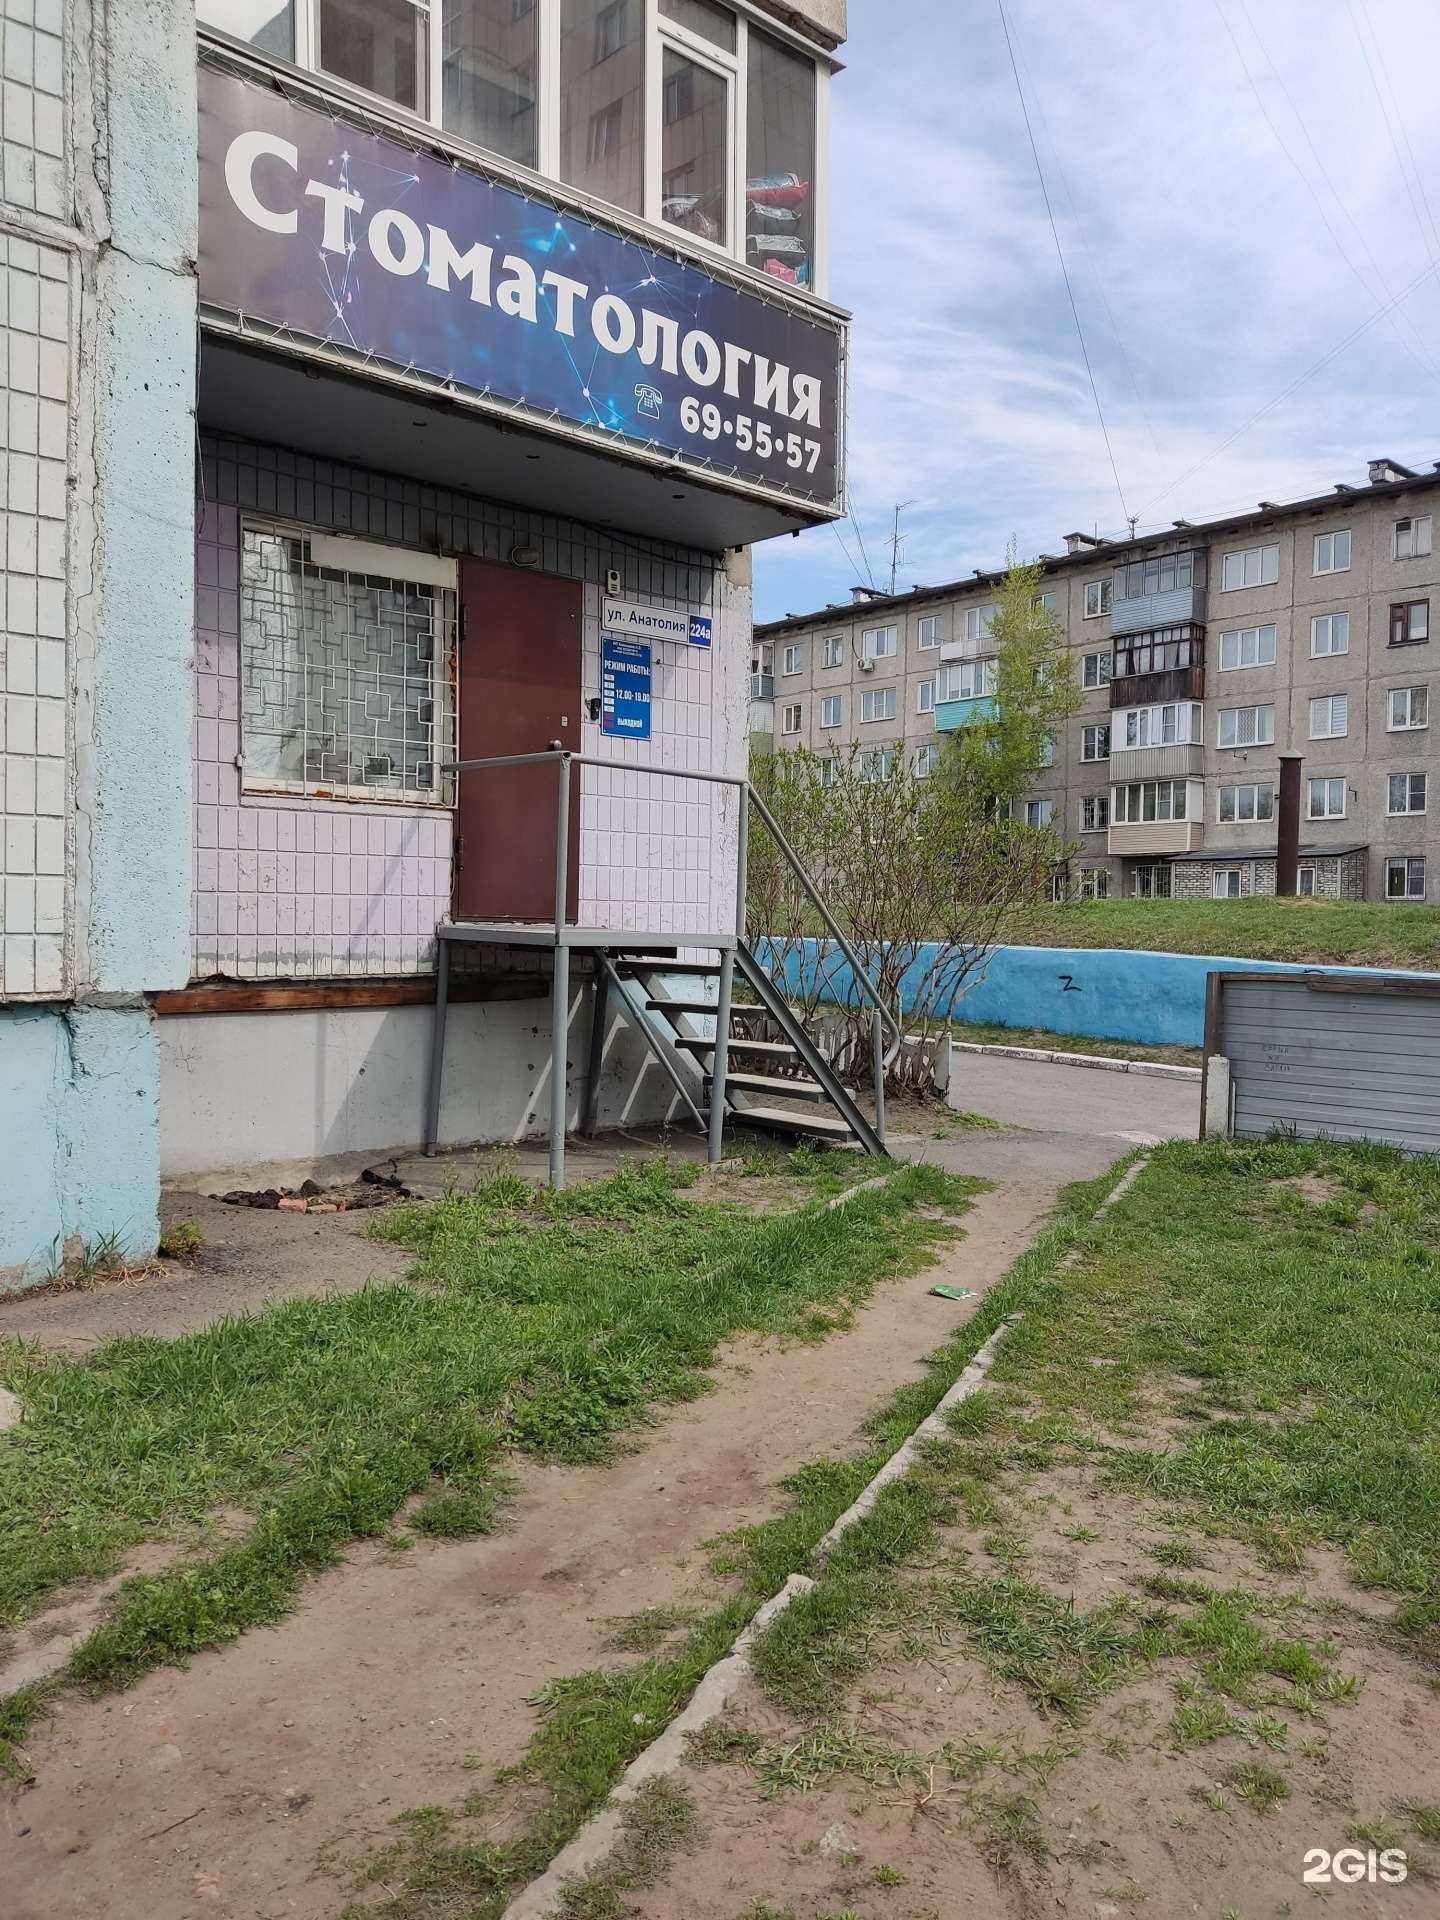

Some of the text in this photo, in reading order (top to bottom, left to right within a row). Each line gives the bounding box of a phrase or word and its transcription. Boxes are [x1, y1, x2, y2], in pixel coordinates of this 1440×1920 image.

[224, 131, 823, 428] Стоматология
[607, 608, 686, 633] ул. Анатолия
[690, 623, 711, 640] 224а
[604, 660, 625, 673] РЕЖИМ
